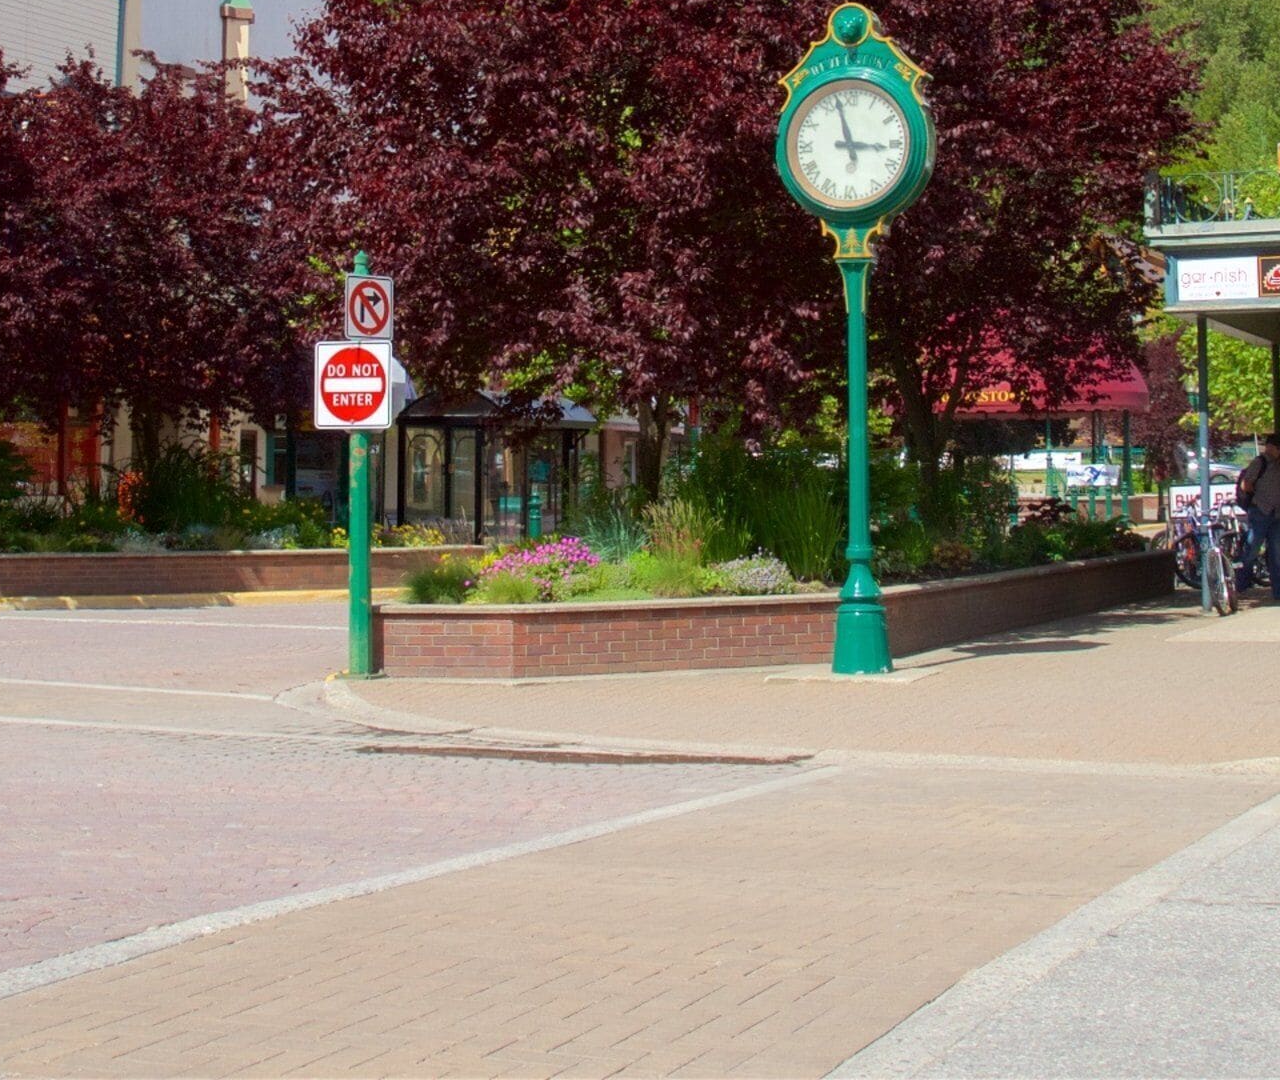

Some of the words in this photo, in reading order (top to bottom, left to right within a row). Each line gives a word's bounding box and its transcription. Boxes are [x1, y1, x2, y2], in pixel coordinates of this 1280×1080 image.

[327, 364, 345, 377] DO
[352, 363, 379, 376] NOT
[332, 393, 373, 407] ENTER
